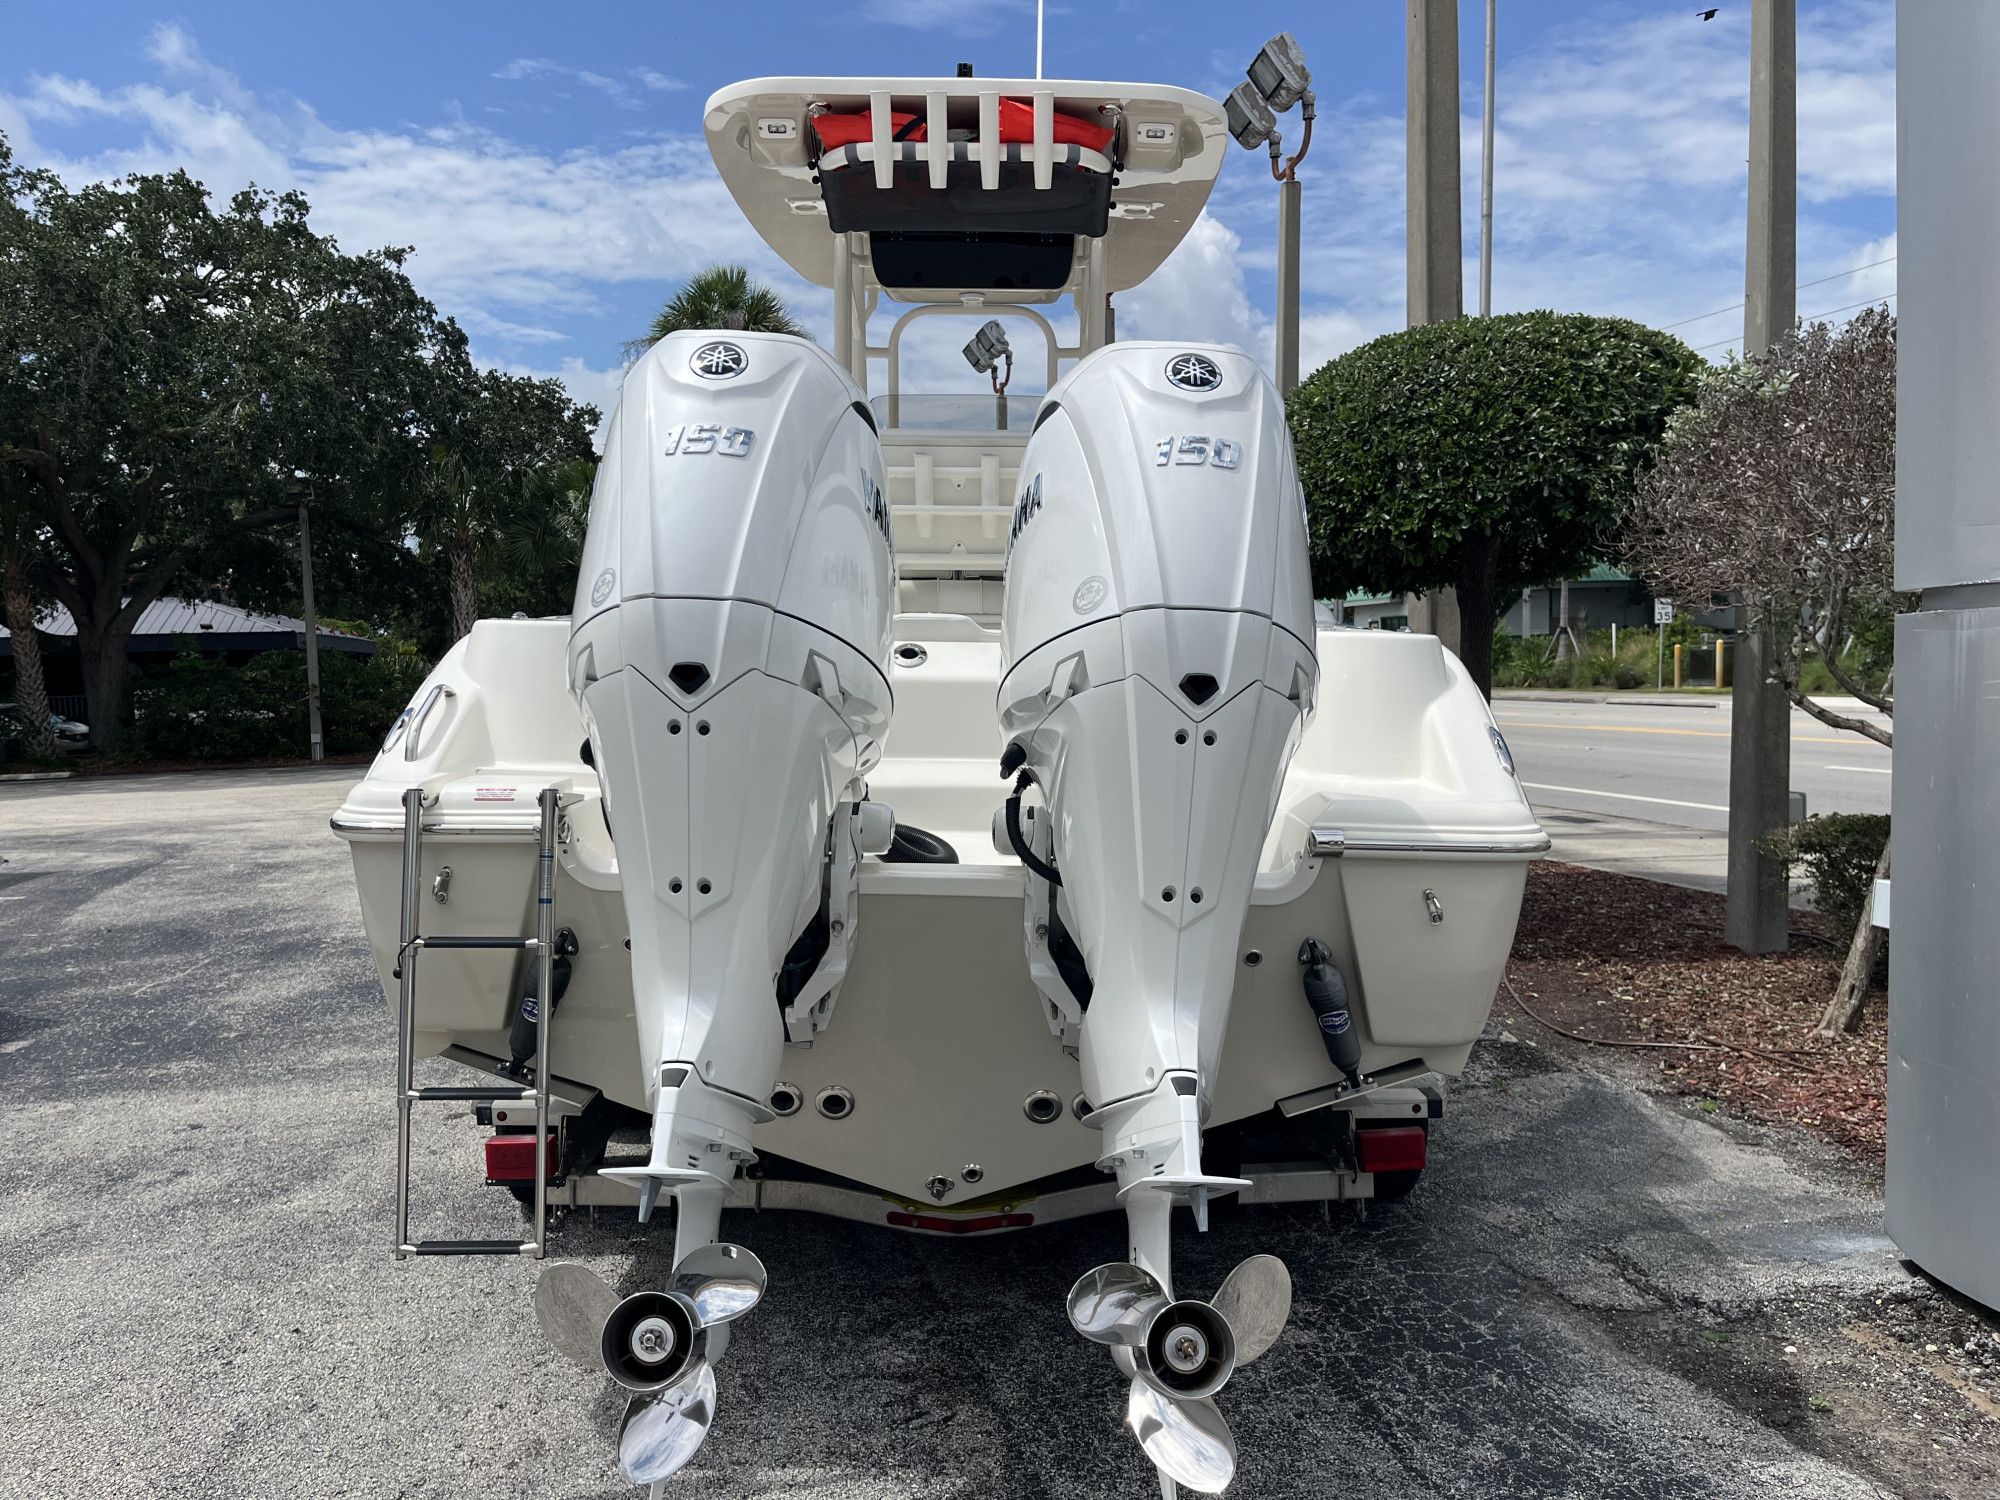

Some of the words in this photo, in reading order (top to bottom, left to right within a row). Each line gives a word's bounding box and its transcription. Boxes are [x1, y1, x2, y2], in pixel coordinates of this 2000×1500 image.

[664, 423, 755, 458] 150
[1156, 435, 1241, 470] 150
[1657, 611, 1671, 622] 35
